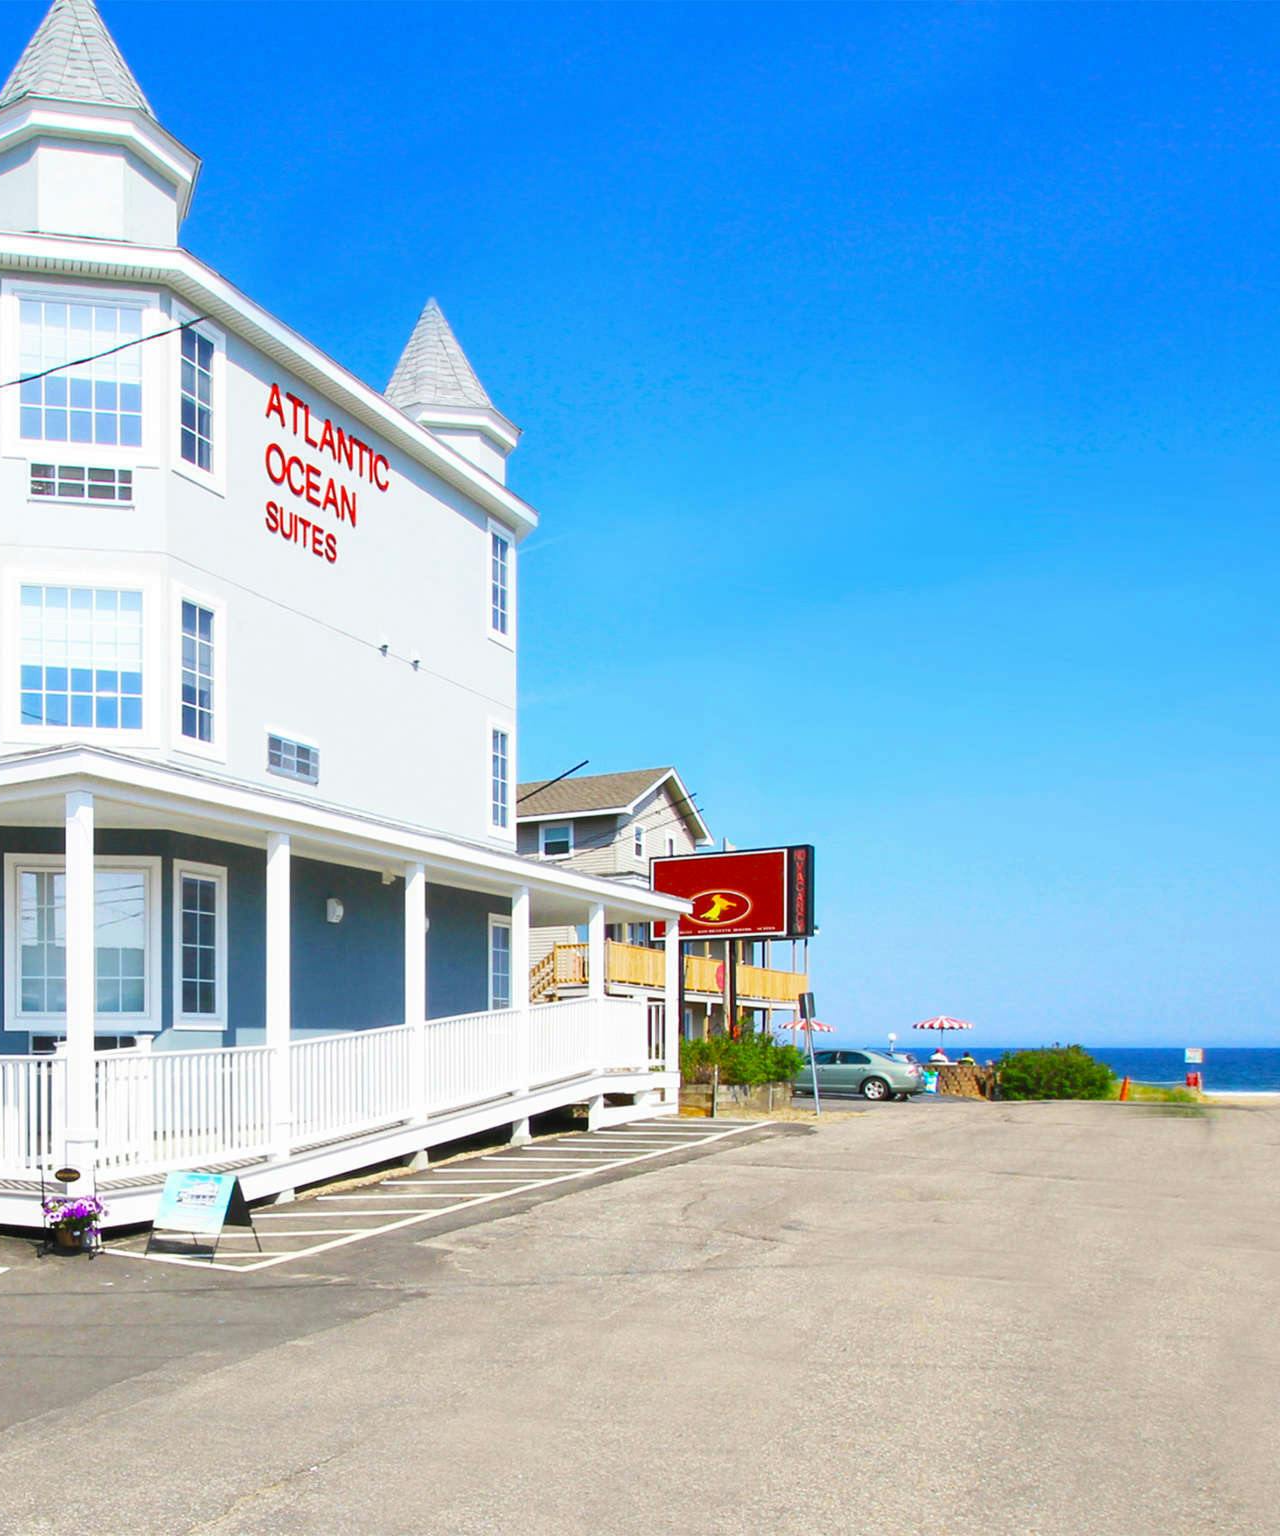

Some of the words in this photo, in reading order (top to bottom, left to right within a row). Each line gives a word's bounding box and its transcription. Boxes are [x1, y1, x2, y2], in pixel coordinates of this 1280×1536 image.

[265, 383, 390, 491] ATLANTIC
[265, 443, 356, 528] OCEAN
[265, 501, 337, 563] SUITES
